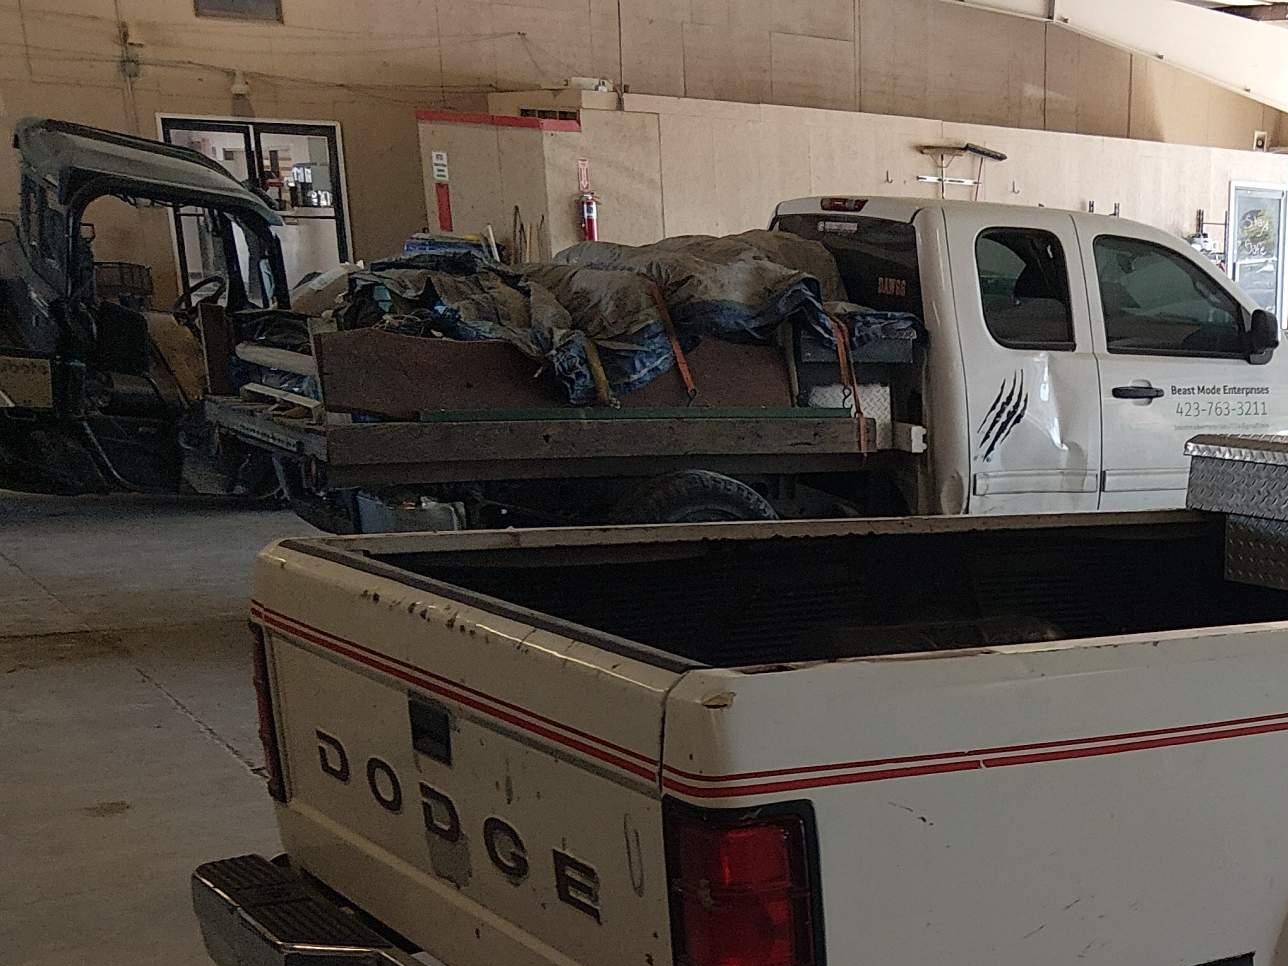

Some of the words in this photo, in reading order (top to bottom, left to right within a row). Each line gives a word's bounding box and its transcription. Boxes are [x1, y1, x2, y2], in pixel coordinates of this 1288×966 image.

[1171, 386, 1195, 396] Beast
[1198, 386, 1221, 396] Mode
[1223, 386, 1270, 397] Enterprises
[1175, 401, 1268, 417] 423-763-3211
[315, 728, 602, 926] DODGE
